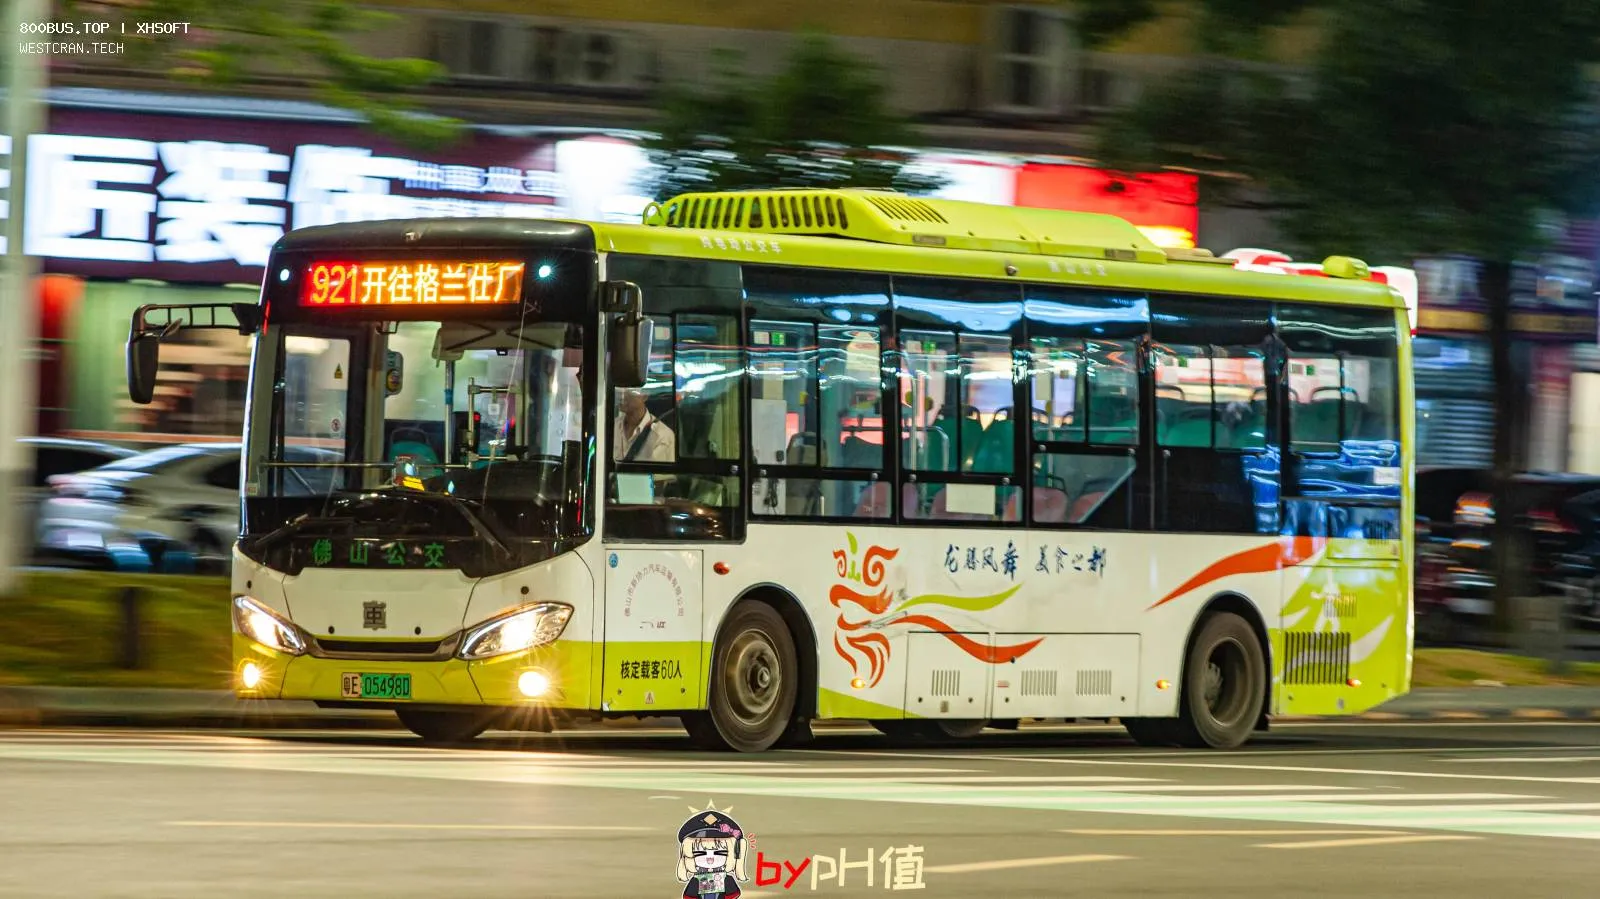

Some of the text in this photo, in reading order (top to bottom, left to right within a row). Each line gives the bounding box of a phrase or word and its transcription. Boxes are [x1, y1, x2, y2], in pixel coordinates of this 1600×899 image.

[312, 263, 523, 304] 921 开往格兰仕厂
[312, 539, 445, 567] 佛山公交
[620, 659, 683, 680] 核定载客60人
